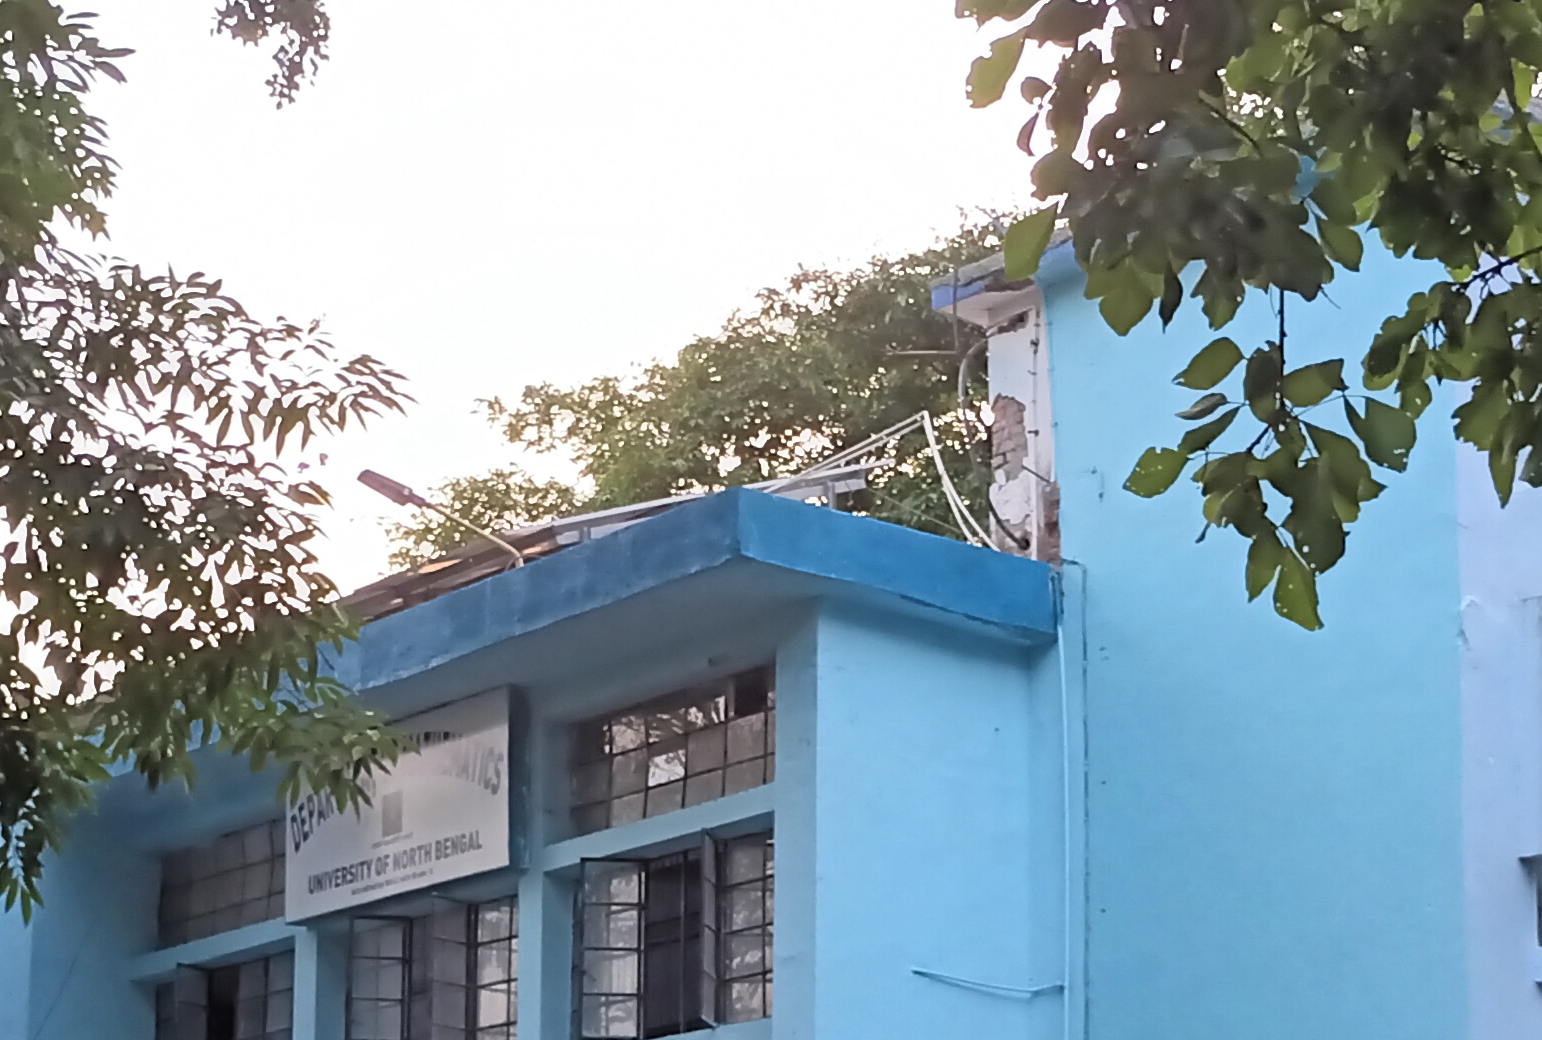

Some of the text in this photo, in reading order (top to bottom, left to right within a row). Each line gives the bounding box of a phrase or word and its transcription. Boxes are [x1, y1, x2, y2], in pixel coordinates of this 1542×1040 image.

[308, 859, 373, 894] UNIVERSITY
[374, 854, 390, 877] OF
[392, 843, 433, 872] NORTH
[434, 830, 483, 861] BENGAL
